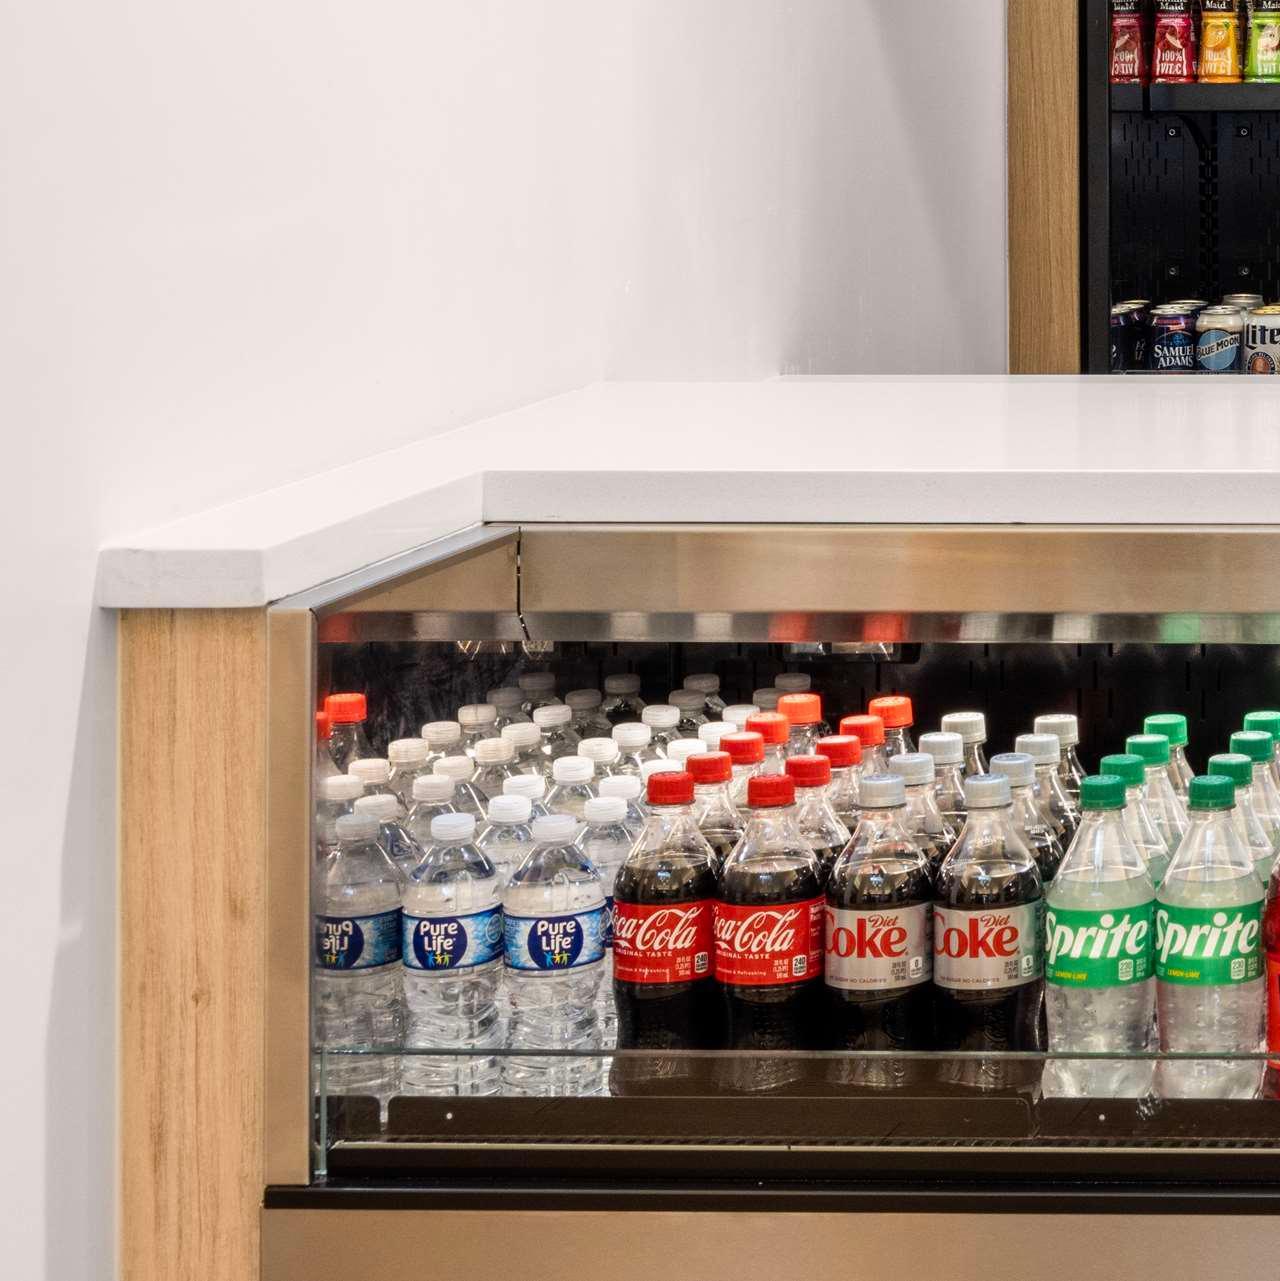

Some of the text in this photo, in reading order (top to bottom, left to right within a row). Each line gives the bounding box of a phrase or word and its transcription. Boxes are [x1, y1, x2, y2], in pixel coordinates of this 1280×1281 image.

[1161, 2, 1184, 10] Maid
[1206, 0, 1226, 9] Maid
[1217, 334, 1240, 350] MOON
[1154, 345, 1193, 357] SAMUEL
[1158, 356, 1193, 368] ADAMS
[537, 920, 576, 936] Pure
[868, 914, 899, 928] Diet
[981, 914, 1009, 928] Diet
[420, 921, 457, 936] Pure
[1046, 912, 1148, 964] Sprite
[1156, 909, 1258, 963] Sprite
[425, 935, 455, 953] Life
[541, 935, 572, 952] Life
[696, 955, 707, 963] 240
[795, 958, 805, 966] 240
